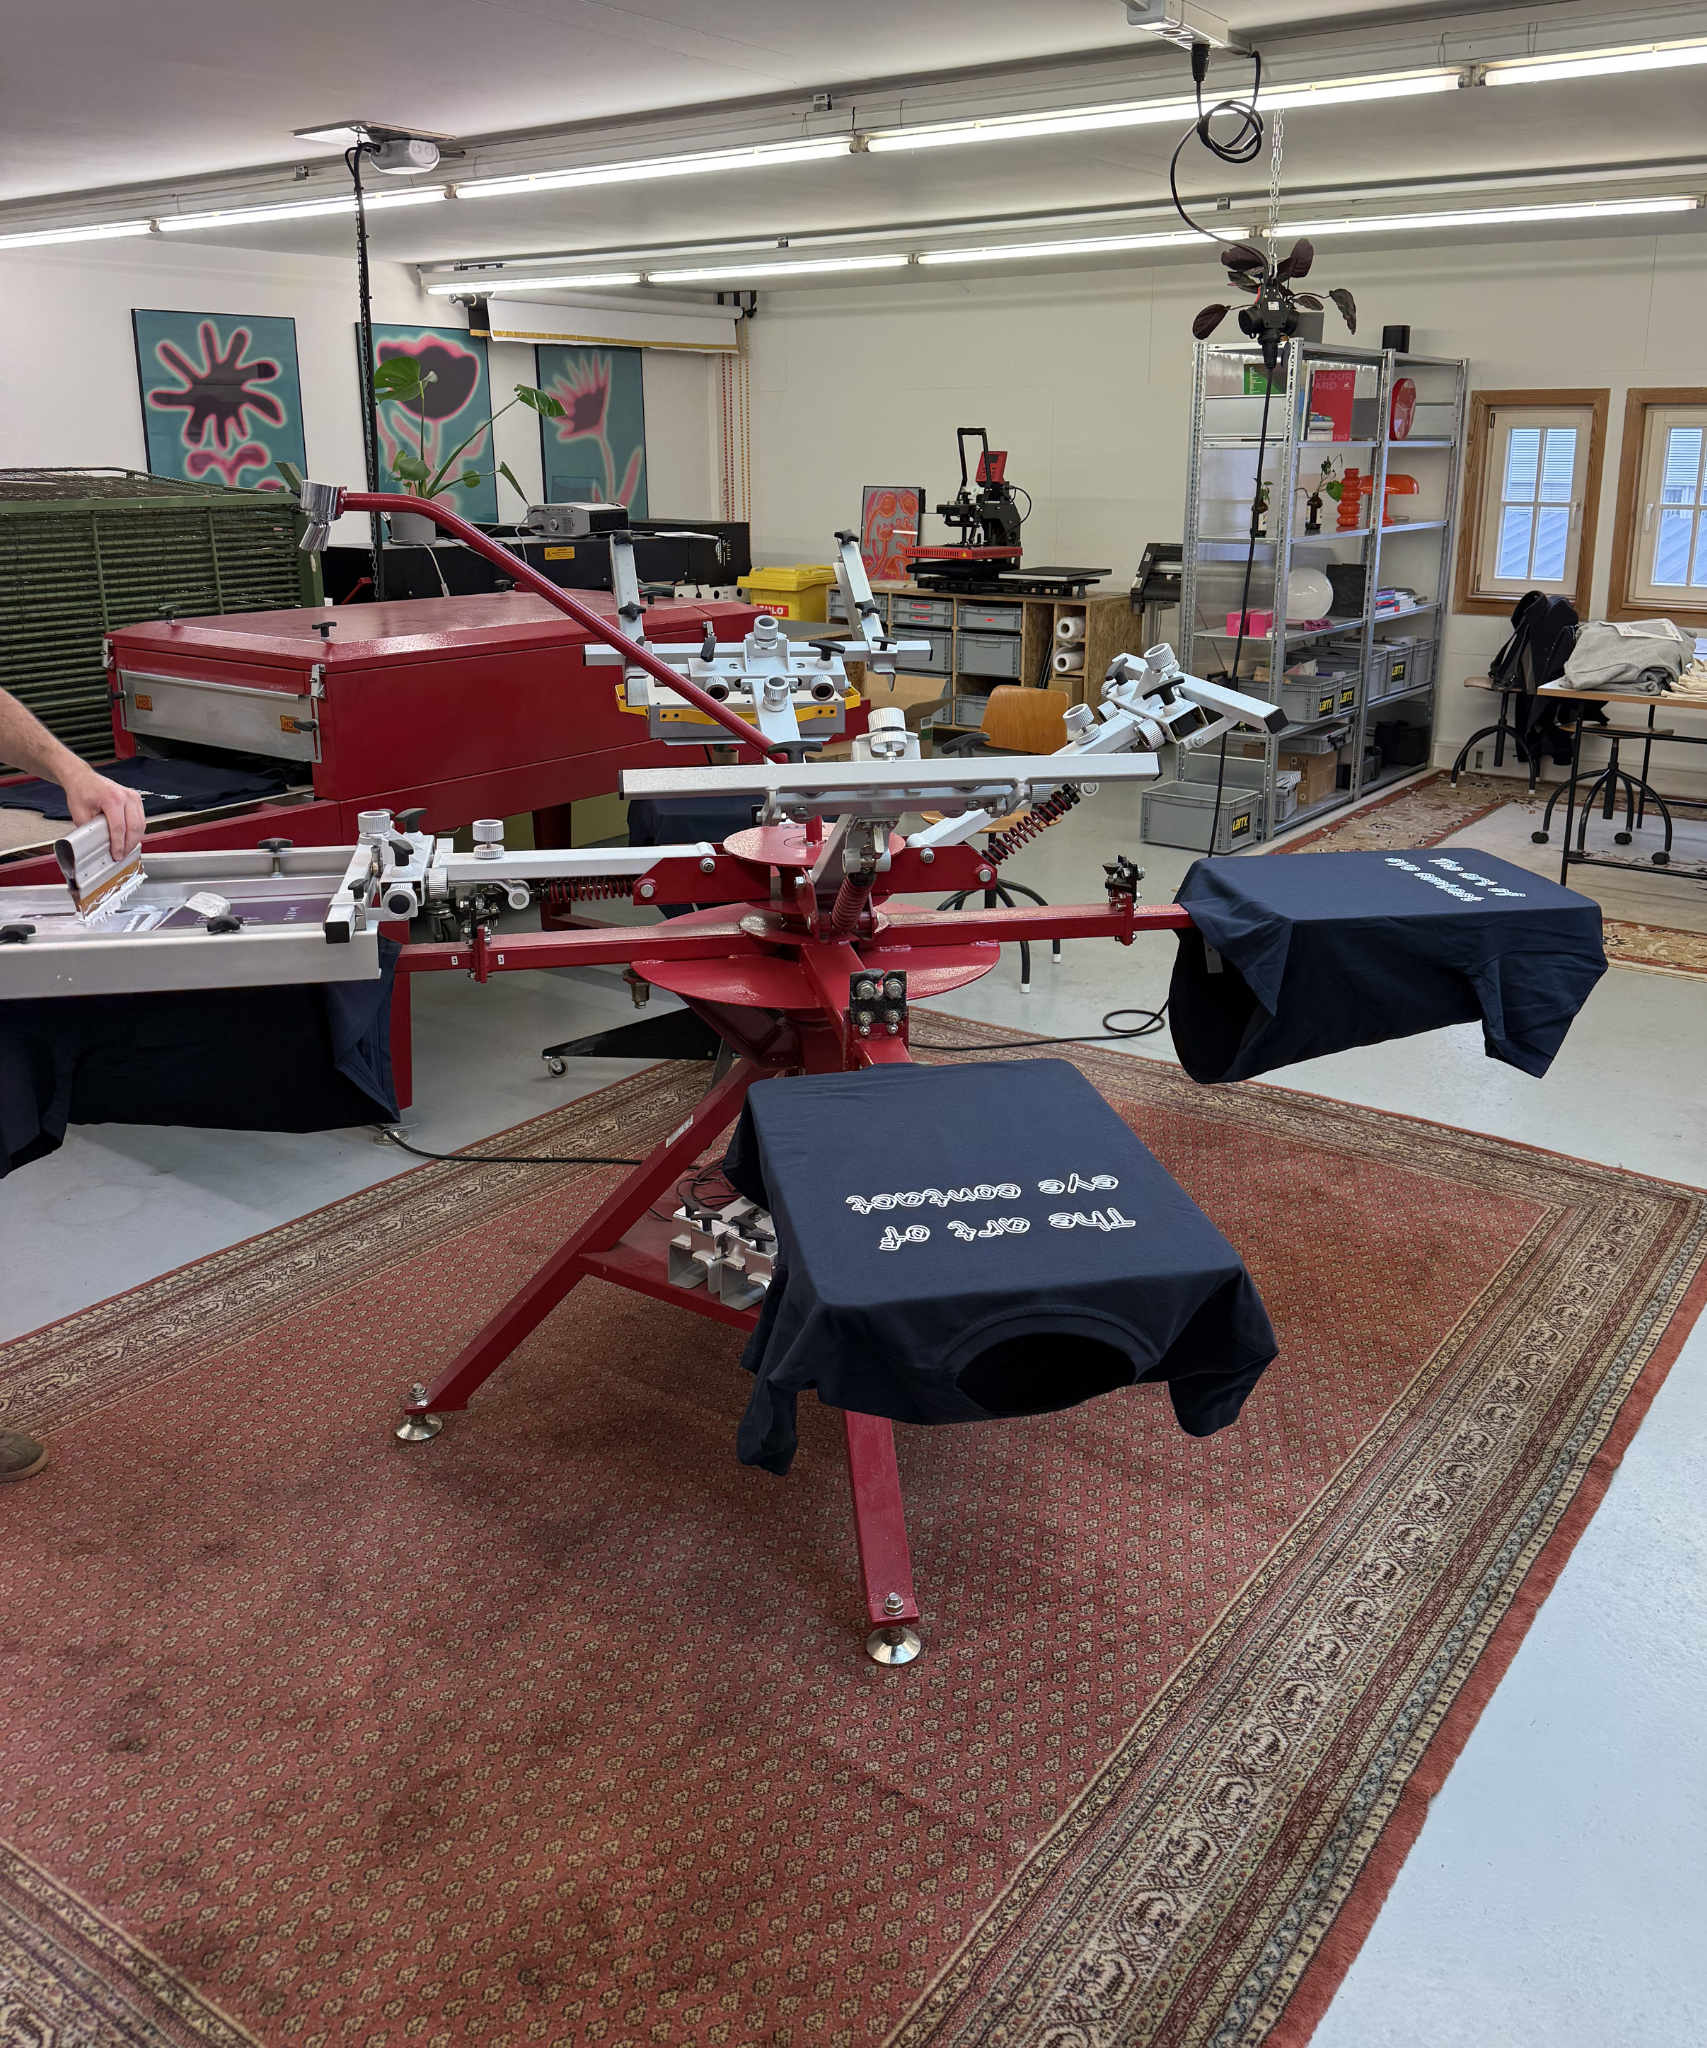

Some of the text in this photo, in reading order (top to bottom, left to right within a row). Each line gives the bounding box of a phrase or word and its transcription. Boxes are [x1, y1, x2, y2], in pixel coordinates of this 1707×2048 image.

[1316, 372, 1353, 381] OLOUR
[846, 1172, 1119, 1215] eye contact
[879, 1207, 1137, 1251] The art of
